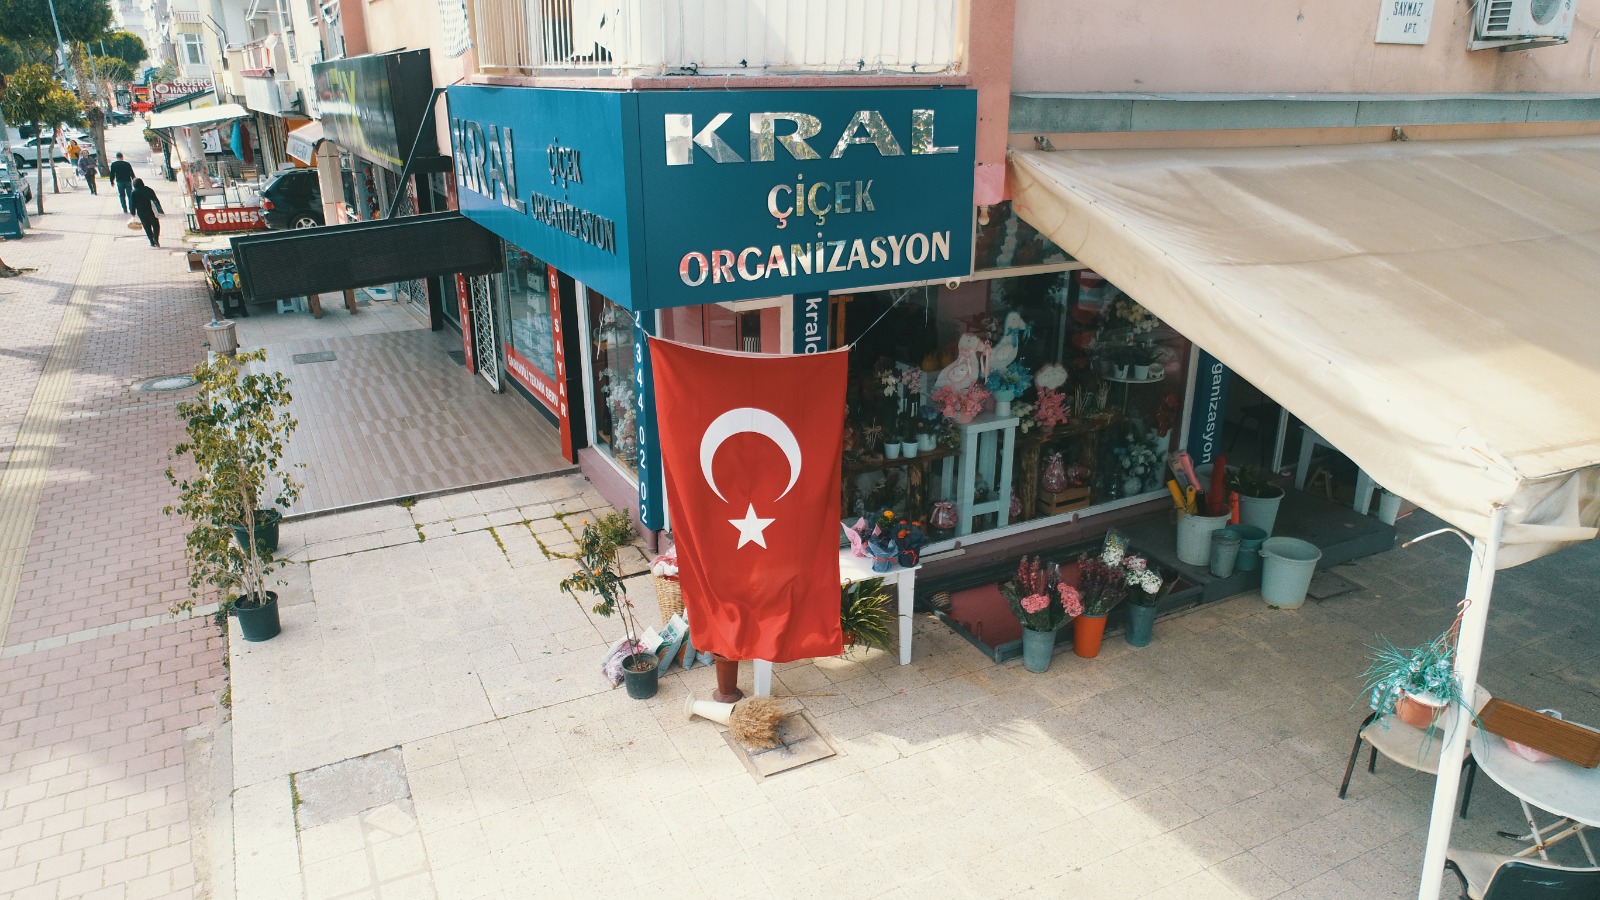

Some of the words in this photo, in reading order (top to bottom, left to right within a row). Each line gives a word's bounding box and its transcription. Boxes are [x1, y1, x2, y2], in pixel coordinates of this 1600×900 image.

[1392, 1, 1424, 17] SAYMAZ
[170, 86, 198, 94] HASAN
[547, 136, 583, 189] ÇİÇEK
[664, 109, 959, 166] KRAL
[453, 117, 527, 216] KRAL
[203, 209, 259, 226] GÜNEŞ
[530, 190, 616, 256] ORGANİZASYON
[767, 173, 876, 229] ÇİÇEK
[678, 230, 951, 287] ORGANİZASYON
[459, 272, 471, 357] ERVİS
[1201, 362, 1224, 464] ganizasyon
